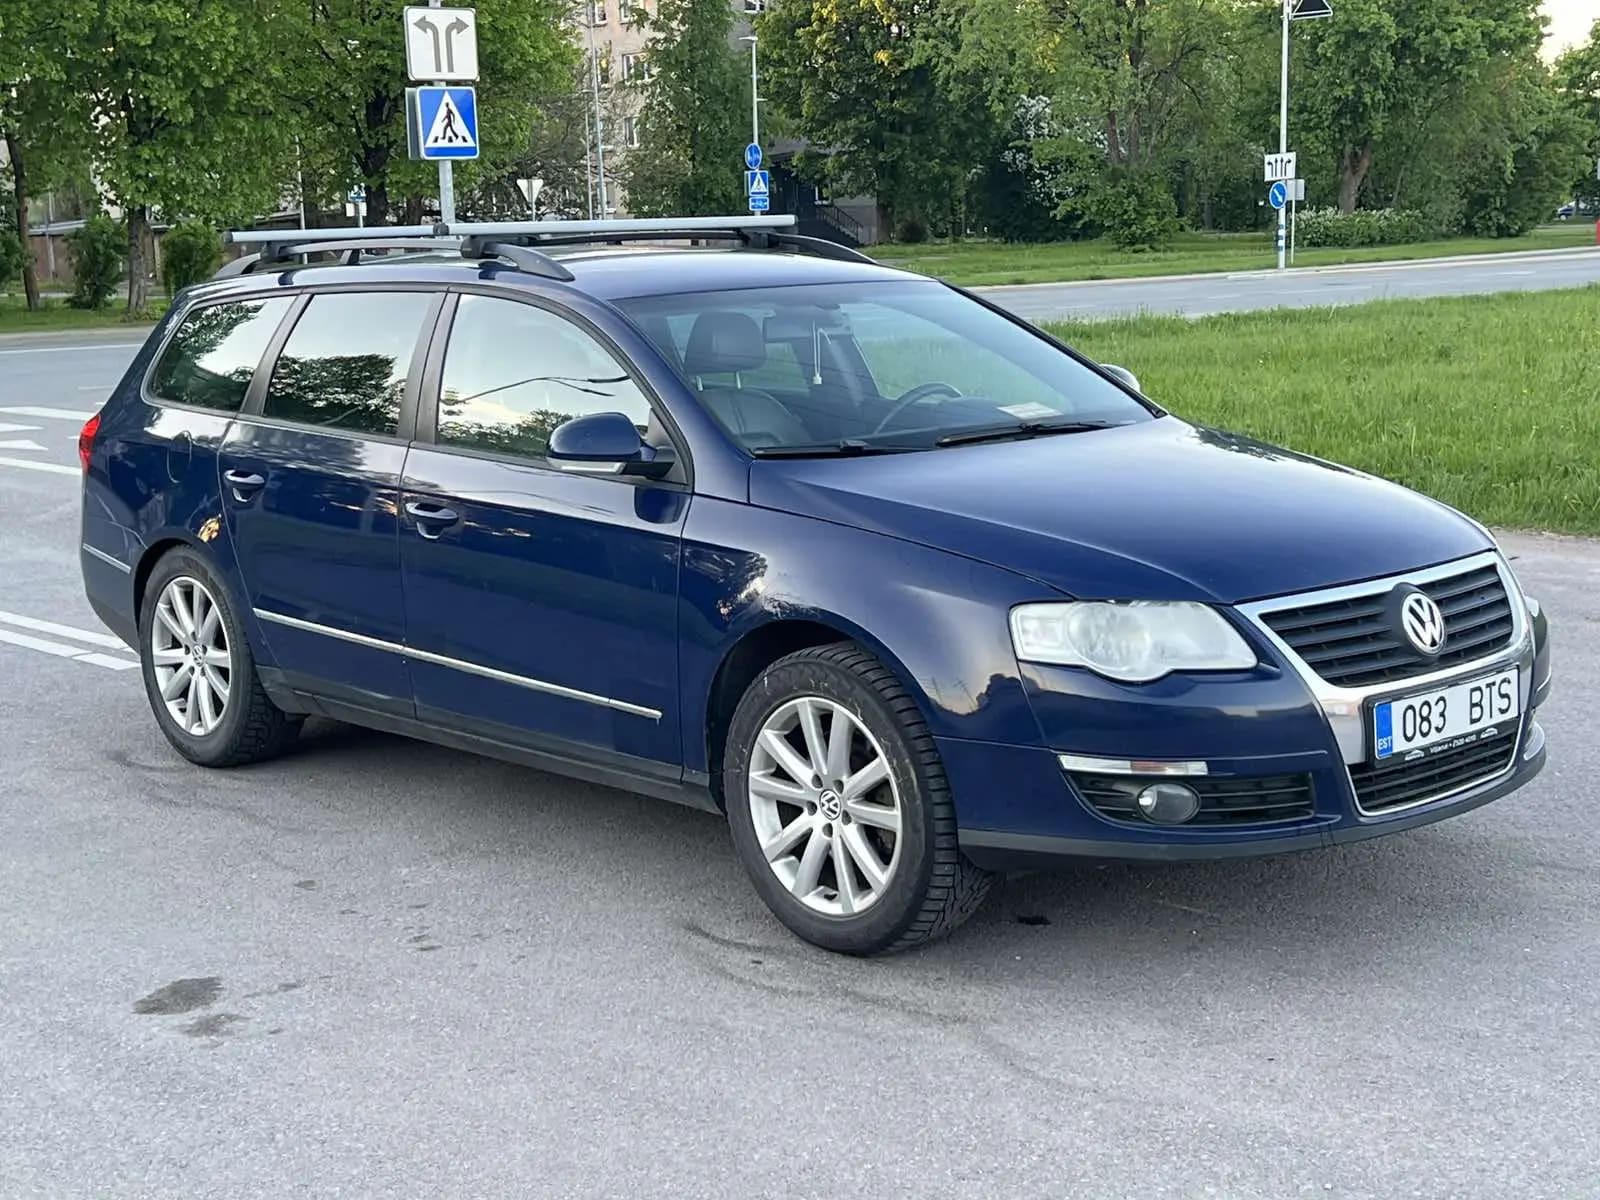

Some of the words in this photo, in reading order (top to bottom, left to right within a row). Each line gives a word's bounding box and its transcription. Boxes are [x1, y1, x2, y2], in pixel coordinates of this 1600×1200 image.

[1403, 594, 1443, 652] VW
[1402, 695, 1447, 743] 083
[1469, 676, 1512, 725] BTS
[1378, 735, 1392, 750] EST
